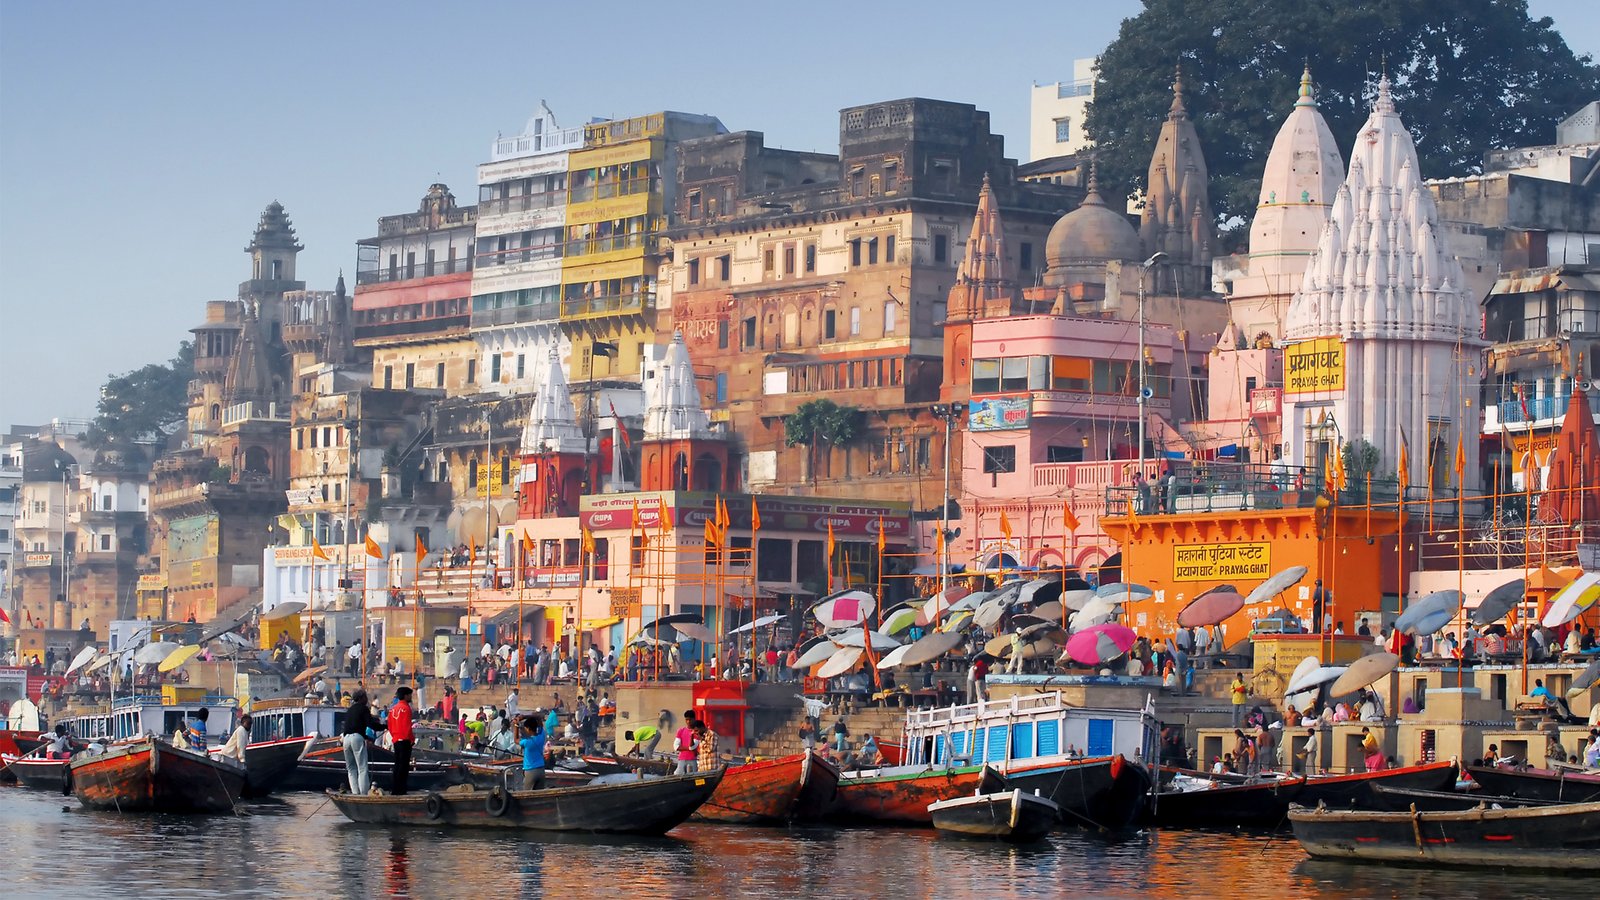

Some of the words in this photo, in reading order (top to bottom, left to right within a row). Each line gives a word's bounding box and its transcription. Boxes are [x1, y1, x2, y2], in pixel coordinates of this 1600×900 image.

[1289, 352, 1320, 375] प्रयाग
[1320, 350, 1340, 368] घाट
[1291, 376, 1319, 388] PRAYAG
[1320, 374, 1340, 386] GHAT
[594, 513, 613, 522] RUPA
[641, 512, 660, 520] RUPA
[873, 520, 901, 529] RUPA
[1177, 546, 1207, 563] महारानी
[1176, 566, 1199, 578] प्रयाग
[1199, 565, 1214, 577] घाट
[1219, 564, 1249, 575] PRAYAG
[1250, 563, 1269, 574] GHAT
